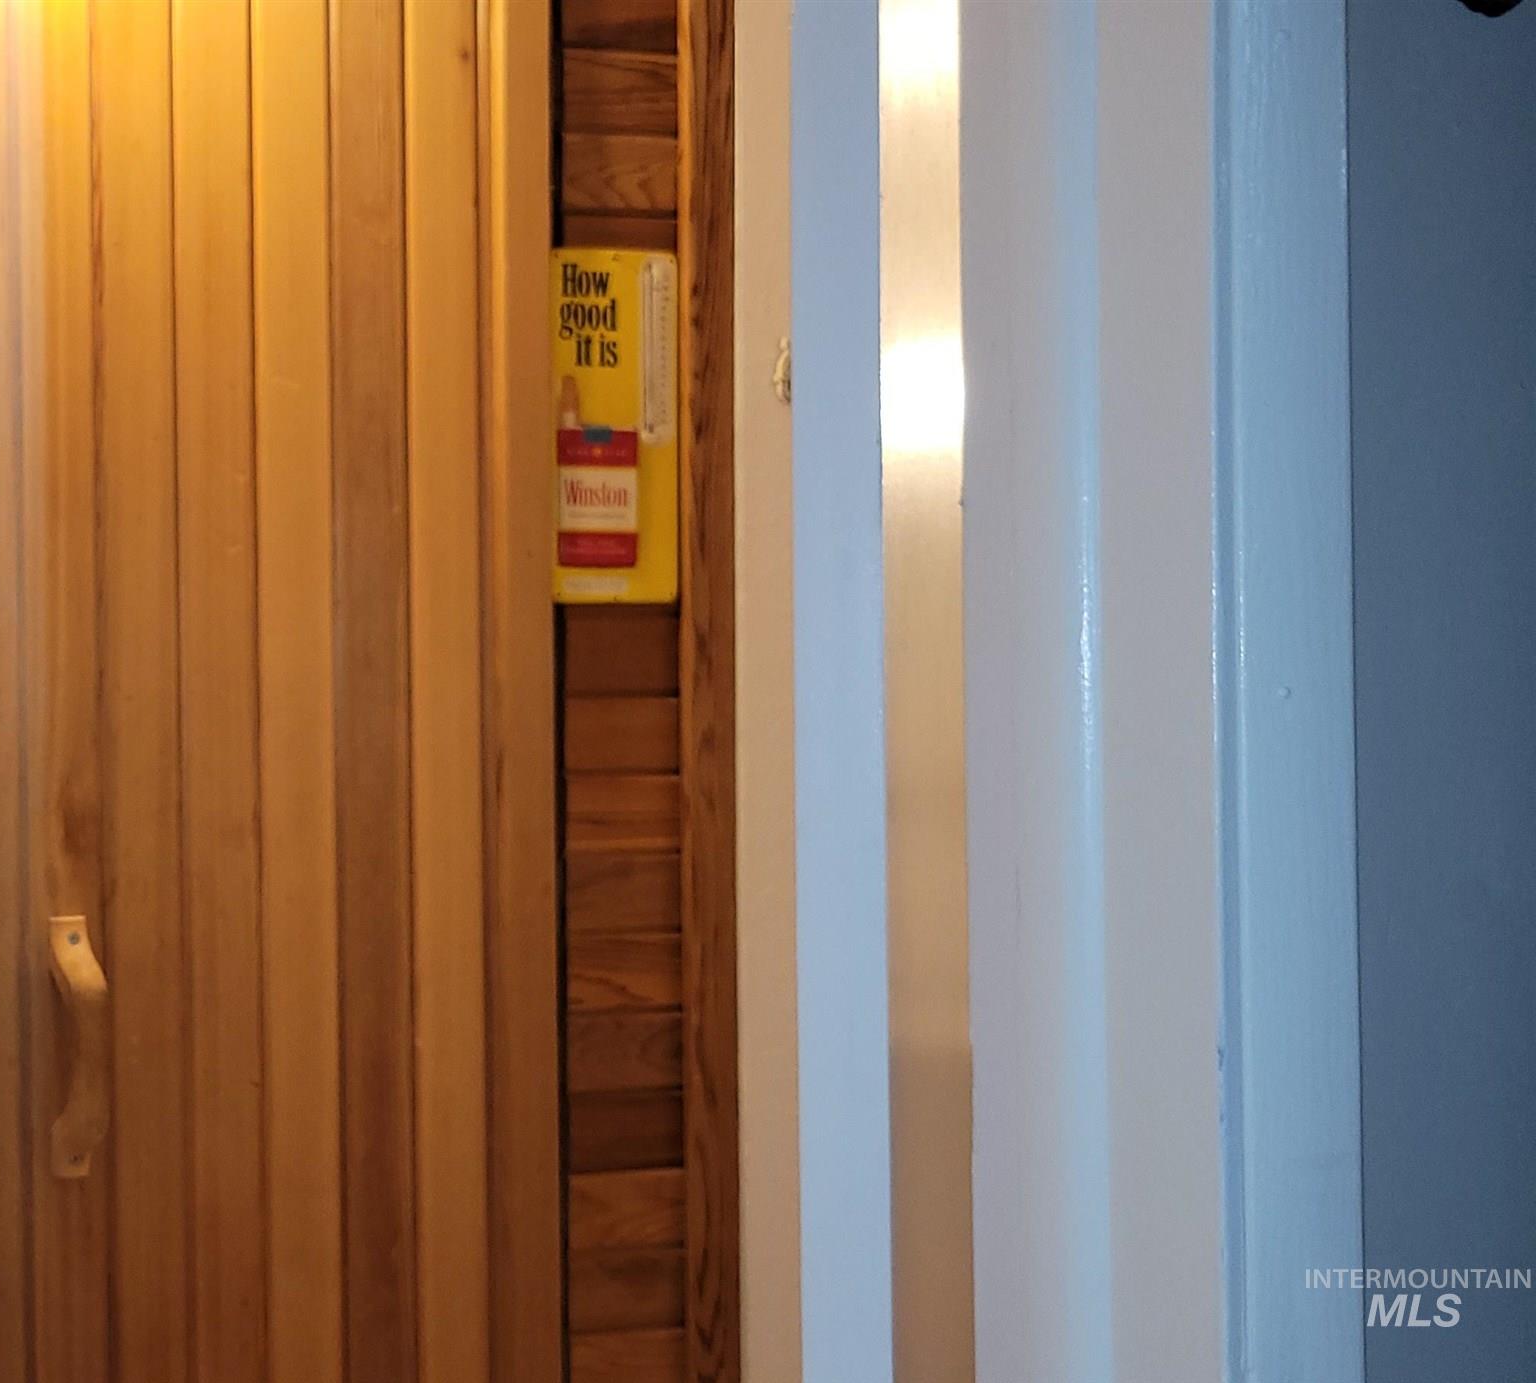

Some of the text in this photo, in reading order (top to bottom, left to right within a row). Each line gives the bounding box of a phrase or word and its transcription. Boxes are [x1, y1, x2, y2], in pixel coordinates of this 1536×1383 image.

[561, 263, 610, 298] How
[559, 299, 617, 341] good
[575, 333, 618, 368] it is
[564, 477, 628, 507] Winston
